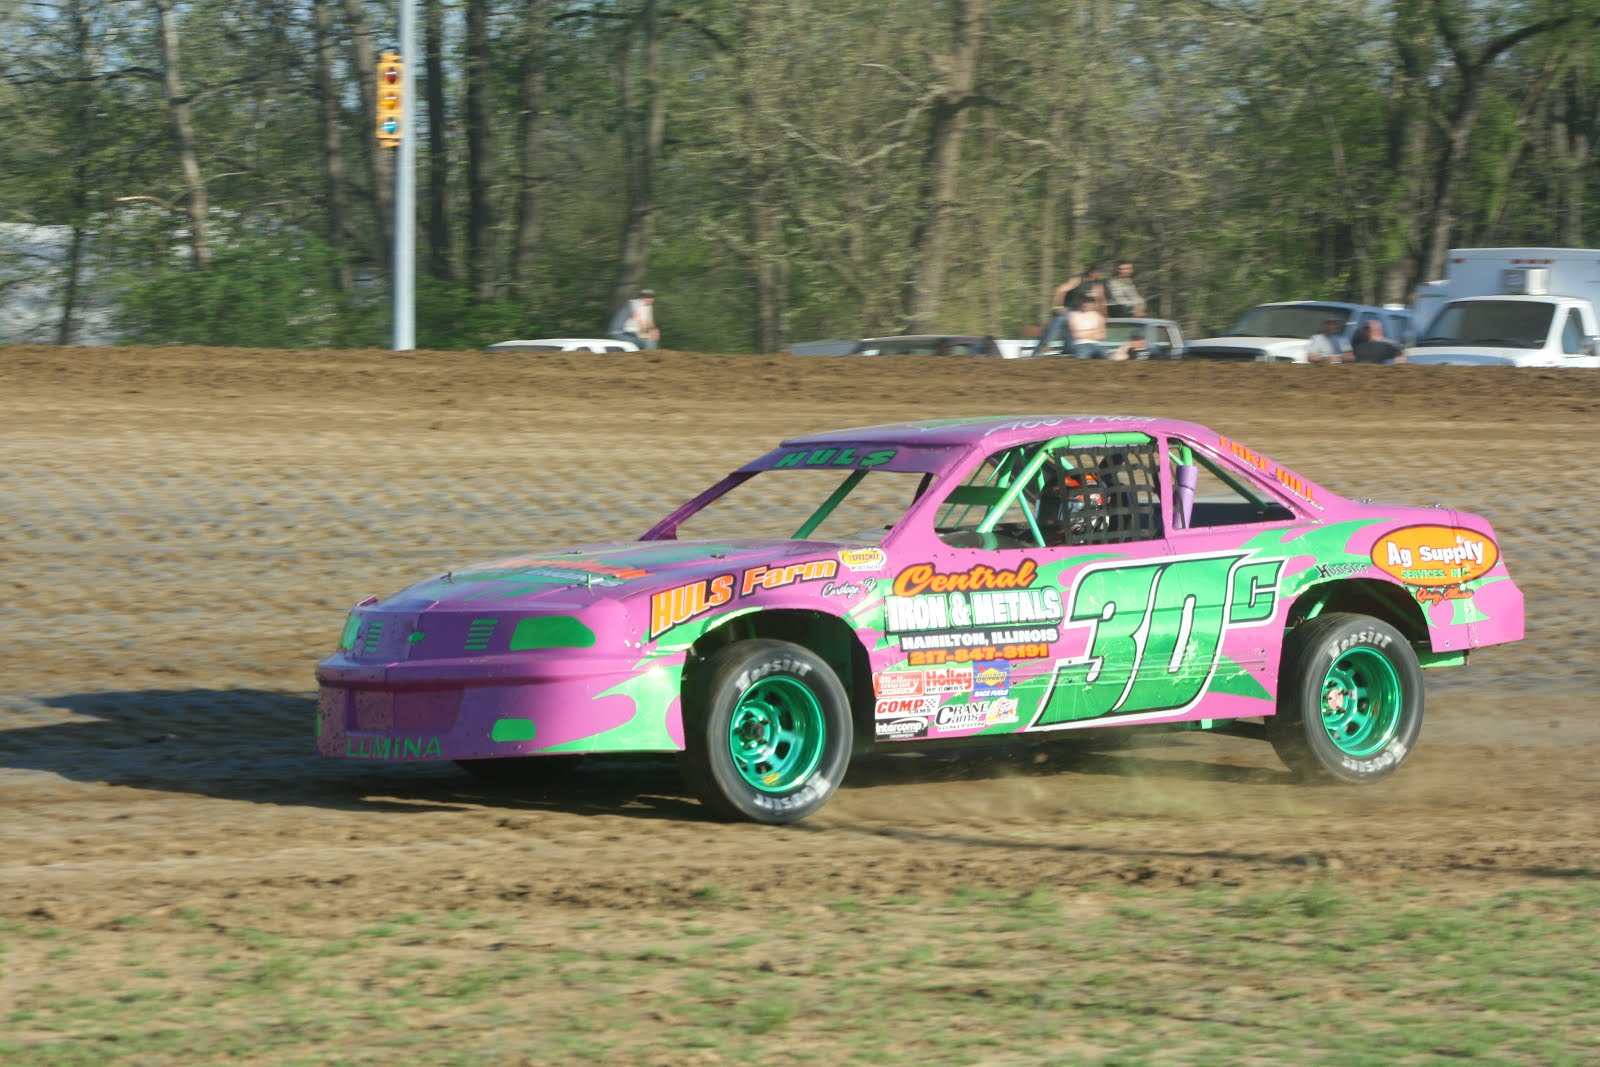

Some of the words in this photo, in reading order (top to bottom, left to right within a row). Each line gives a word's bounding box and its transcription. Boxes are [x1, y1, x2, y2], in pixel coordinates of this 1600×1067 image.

[773, 448, 897, 468] HULS
[1386, 541, 1413, 567] Ag
[1420, 539, 1484, 565] Supply
[893, 558, 1038, 597] Central
[650, 575, 735, 642] HULS
[740, 559, 839, 598] Farm
[886, 594, 948, 632] IRON
[950, 592, 972, 628] &
[971, 587, 1064, 626] METALS
[902, 634, 989, 650] HAMILTON,
[992, 628, 1058, 646] ILLINOIS
[925, 669, 973, 690] Holley
[877, 699, 925, 714] COMP
[935, 702, 989, 726] CRANE
[875, 721, 922, 734] Intercomp
[345, 735, 443, 760] LUMINA
